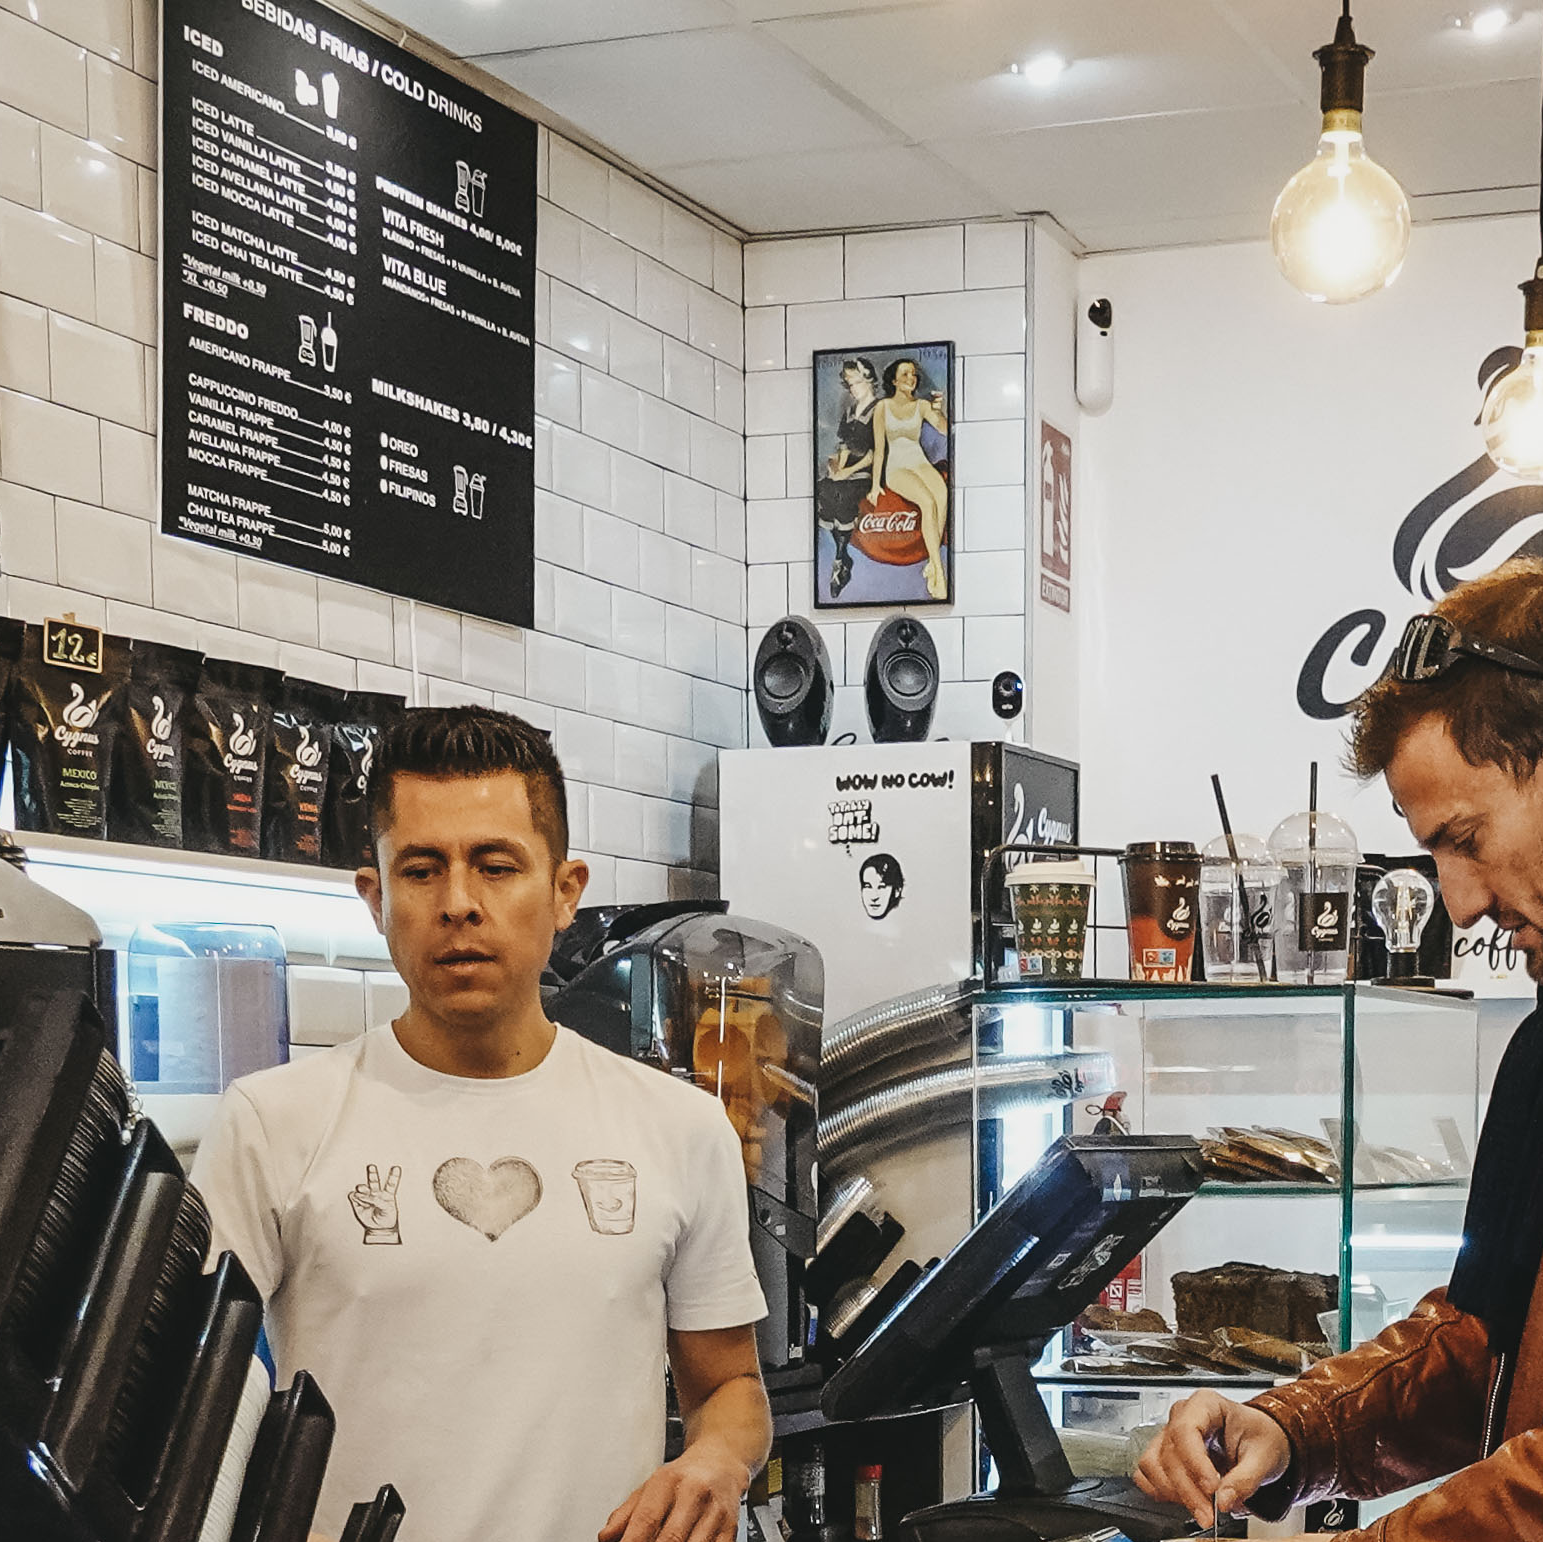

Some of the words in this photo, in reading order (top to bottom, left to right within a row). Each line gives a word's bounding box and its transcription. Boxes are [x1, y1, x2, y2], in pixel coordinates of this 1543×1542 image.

[184, 25, 223, 57] ICED
[192, 59, 219, 81] ICED
[221, 74, 287, 116] AMERICANO
[320, 31, 369, 72] FRIAS
[381, 64, 424, 101] COLD
[428, 90, 482, 132] DRINKS
[192, 97, 219, 119] ICED
[221, 111, 254, 137] LATTE
[192, 116, 219, 137] ICED
[221, 129, 270, 161] VAINILLA
[267, 152, 302, 177] LATTE
[192, 135, 219, 156] ICED
[221, 149, 272, 182] CARAMEL
[274, 172, 307, 198] LATTE
[192, 154, 219, 175] ICED
[218, 167, 277, 201] AVELLANA
[276, 191, 309, 217] LATTE
[192, 173, 219, 193] ICED
[221, 186, 263, 213] MOCCA
[260, 203, 294, 228] LATTE
[426, 201, 467, 230] SHAKES
[192, 211, 219, 231] ICED
[221, 222, 268, 252] MATCHA
[267, 242, 300, 266] LATTE
[382, 207, 408, 232] VITA
[410, 220, 444, 248] FRESH
[192, 229, 219, 249] ICED
[221, 241, 247, 261] CHAI
[249, 252, 273, 271] TEA
[272, 262, 304, 285] LATTE
[382, 254, 411, 280] VITA
[413, 268, 446, 295] BLUE
[184, 303, 248, 339] FREDDO
[189, 336, 250, 367] AMERICANO
[252, 358, 292, 383] FRAPPE
[188, 391, 233, 416] VAINILLA
[235, 407, 276, 430] FRAPPE
[189, 373, 256, 405] CAPPUCCINO
[258, 396, 300, 421] FREDDO
[372, 378, 459, 422] MILKSHAKES
[463, 412, 489, 433] 3,80
[188, 410, 238, 436] CARAMEL
[240, 426, 280, 449] FRAPPE
[189, 429, 240, 455] AVELLANA
[242, 445, 282, 468] FRAPPE
[387, 437, 418, 457] OREO
[188, 447, 229, 468] MOCCA
[228, 459, 269, 481] FRAPPE
[387, 459, 427, 482] FRESAS
[188, 484, 233, 506] MATCHA
[232, 496, 273, 518] FRAPPE
[387, 482, 436, 507] FILIPINOS
[188, 502, 213, 519] CHAI
[215, 509, 235, 525] TEA
[237, 515, 277, 537] FRAPPE
[54, 725, 99, 747] Cygnus
[62, 768, 97, 780] MEXICO
[836, 774, 878, 791] WOW
[882, 773, 905, 789] NO
[908, 770, 954, 789] COW!
